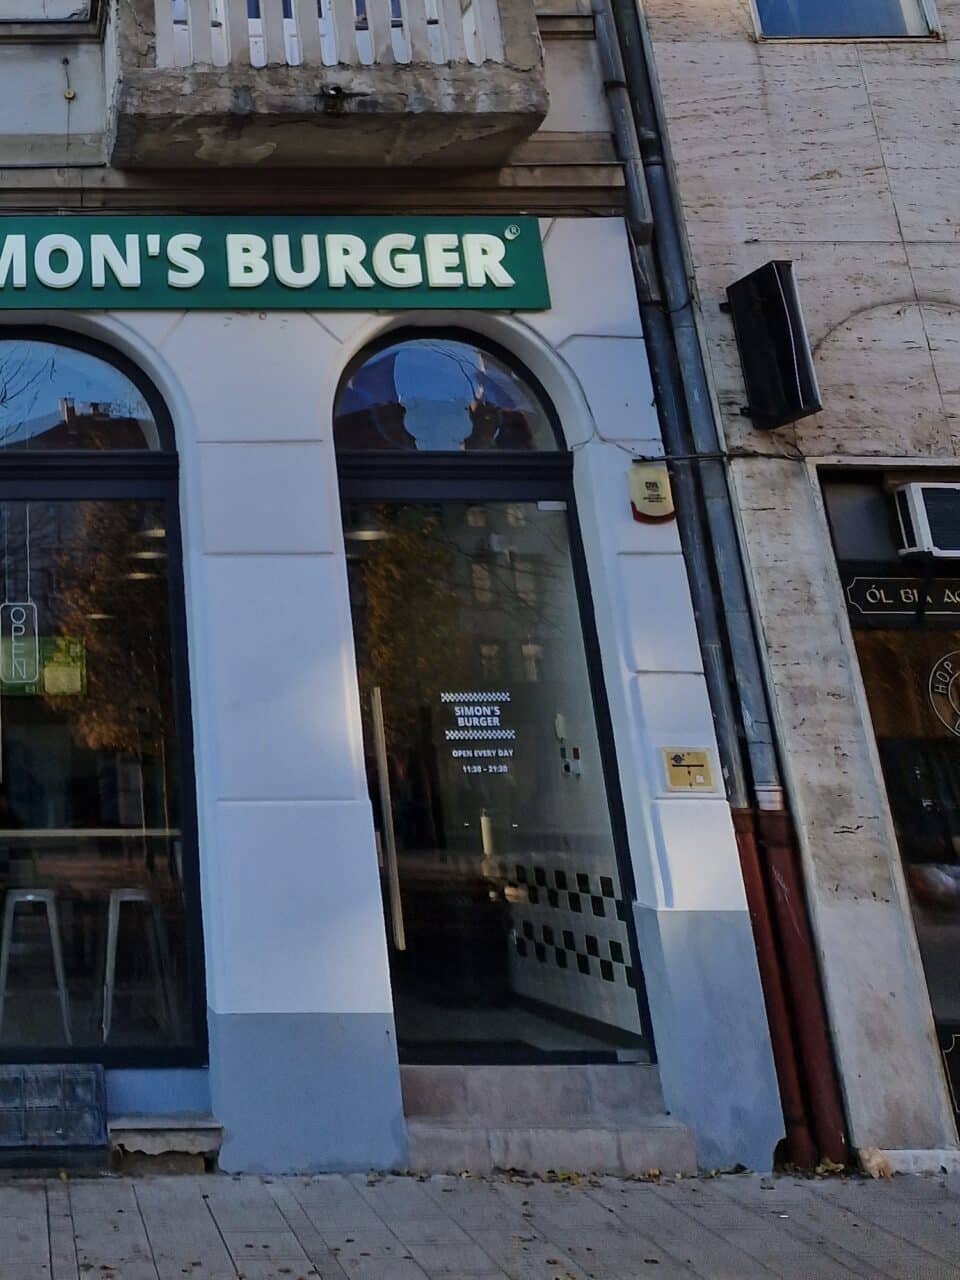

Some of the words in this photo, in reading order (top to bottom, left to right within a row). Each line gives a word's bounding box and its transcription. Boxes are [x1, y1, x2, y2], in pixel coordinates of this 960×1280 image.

[866, 584, 894, 604] ÓL
[11, 607, 26, 679] OPEN
[454, 706, 501, 716] SIMON'S
[458, 717, 500, 727] BURGER
